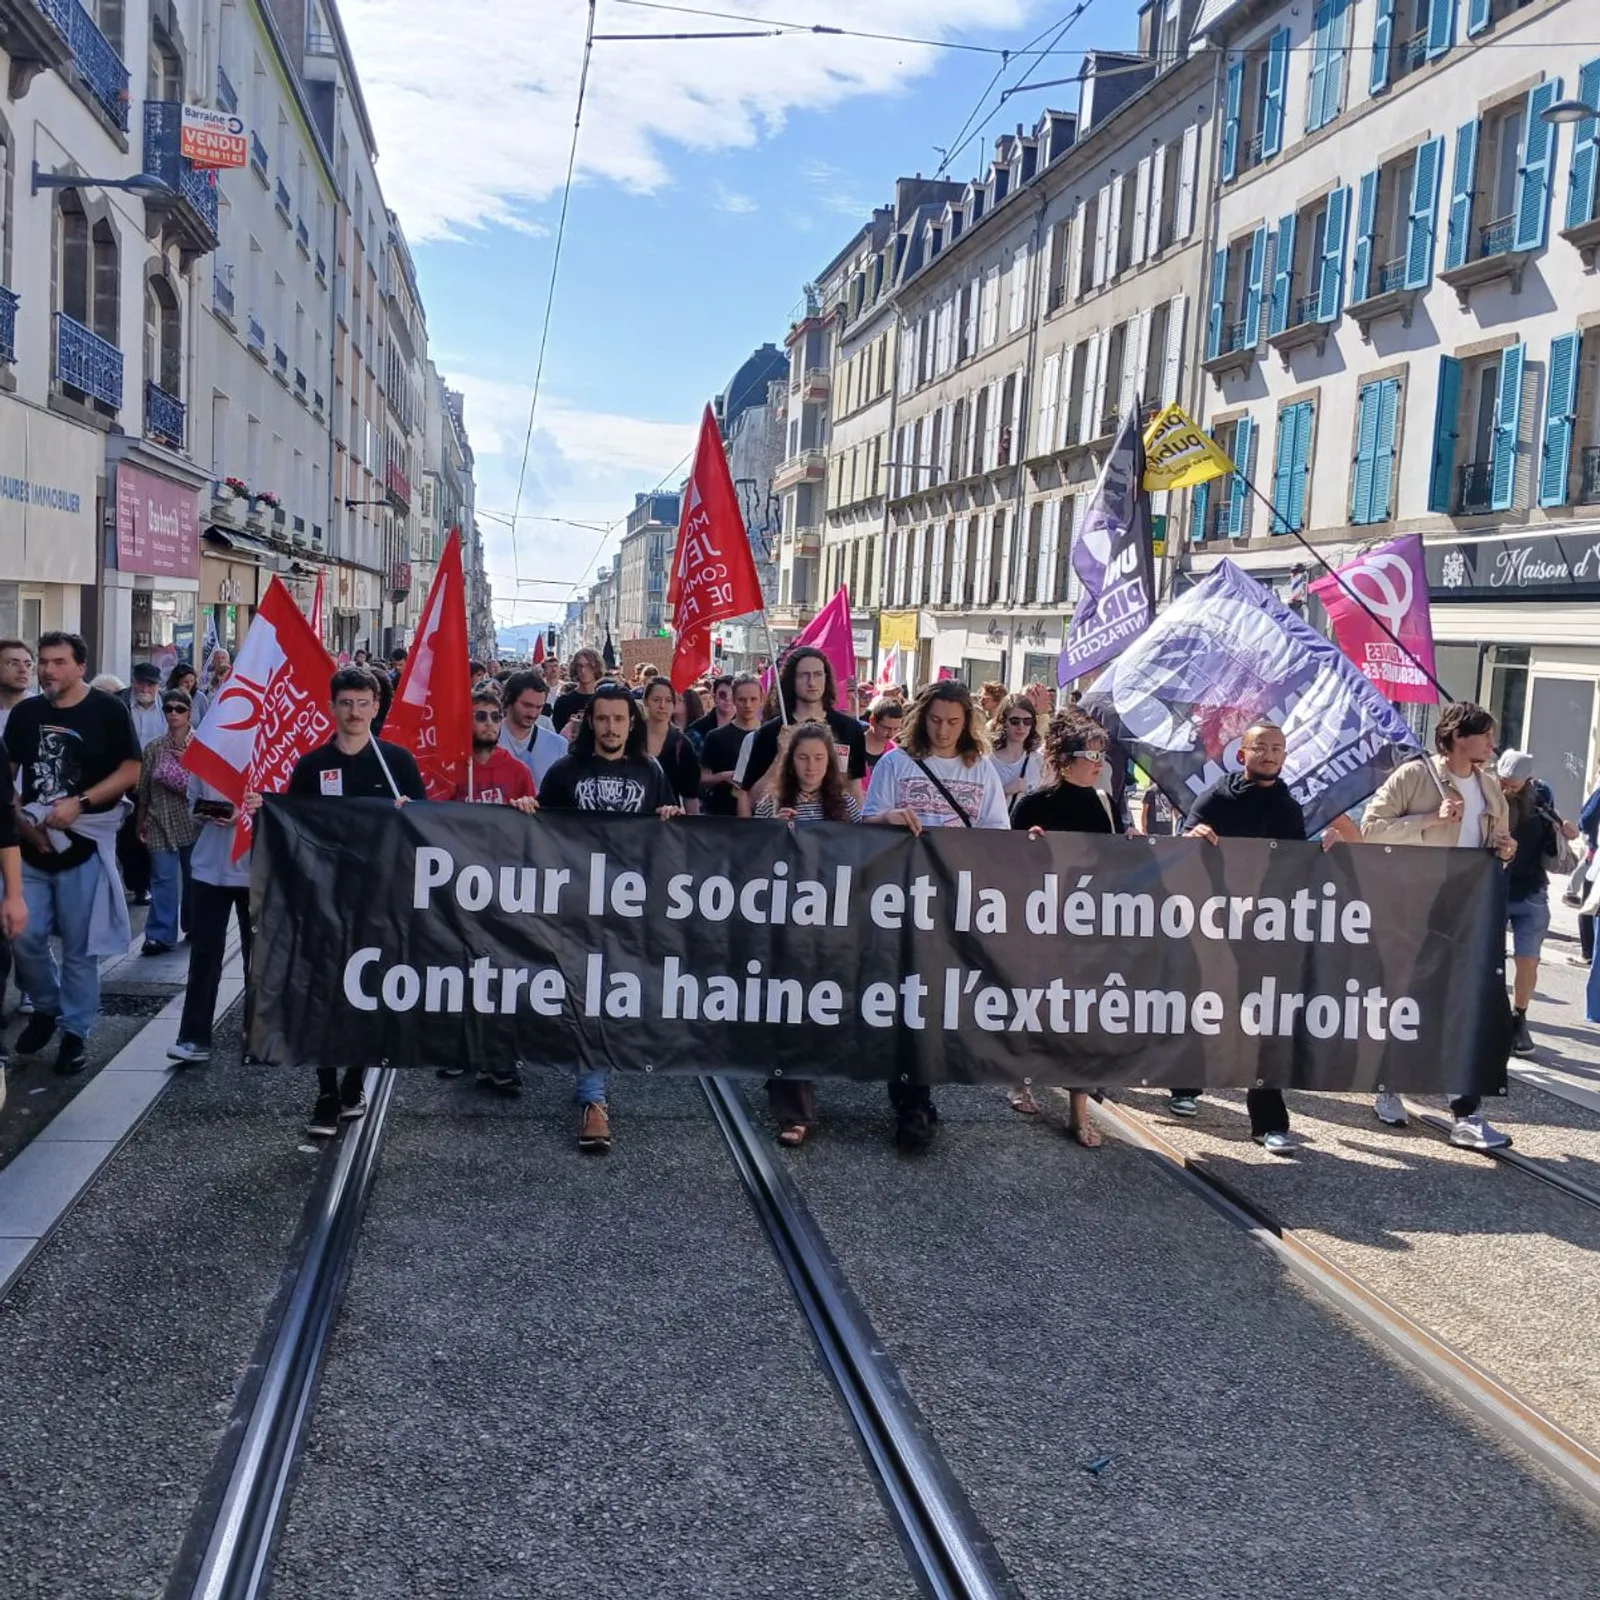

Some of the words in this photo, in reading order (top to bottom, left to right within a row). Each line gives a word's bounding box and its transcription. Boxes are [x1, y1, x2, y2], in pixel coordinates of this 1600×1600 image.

[184, 106, 225, 123] Barraine
[184, 128, 243, 153] VENDU
[31, 483, 81, 514] IMMOBILIER
[1490, 546, 1568, 588] Maison
[413, 847, 570, 914] Pour
[589, 852, 646, 917] le
[666, 861, 852, 927] social
[870, 875, 937, 931] et
[955, 870, 1007, 934] la
[1025, 873, 1372, 944] démocratie
[344, 948, 566, 1017] Contre
[585, 953, 641, 1018] la
[662, 956, 843, 1025] haine
[861, 973, 928, 1029] et
[944, 968, 1224, 1035] l'extrême
[1240, 976, 1420, 1041] droite
